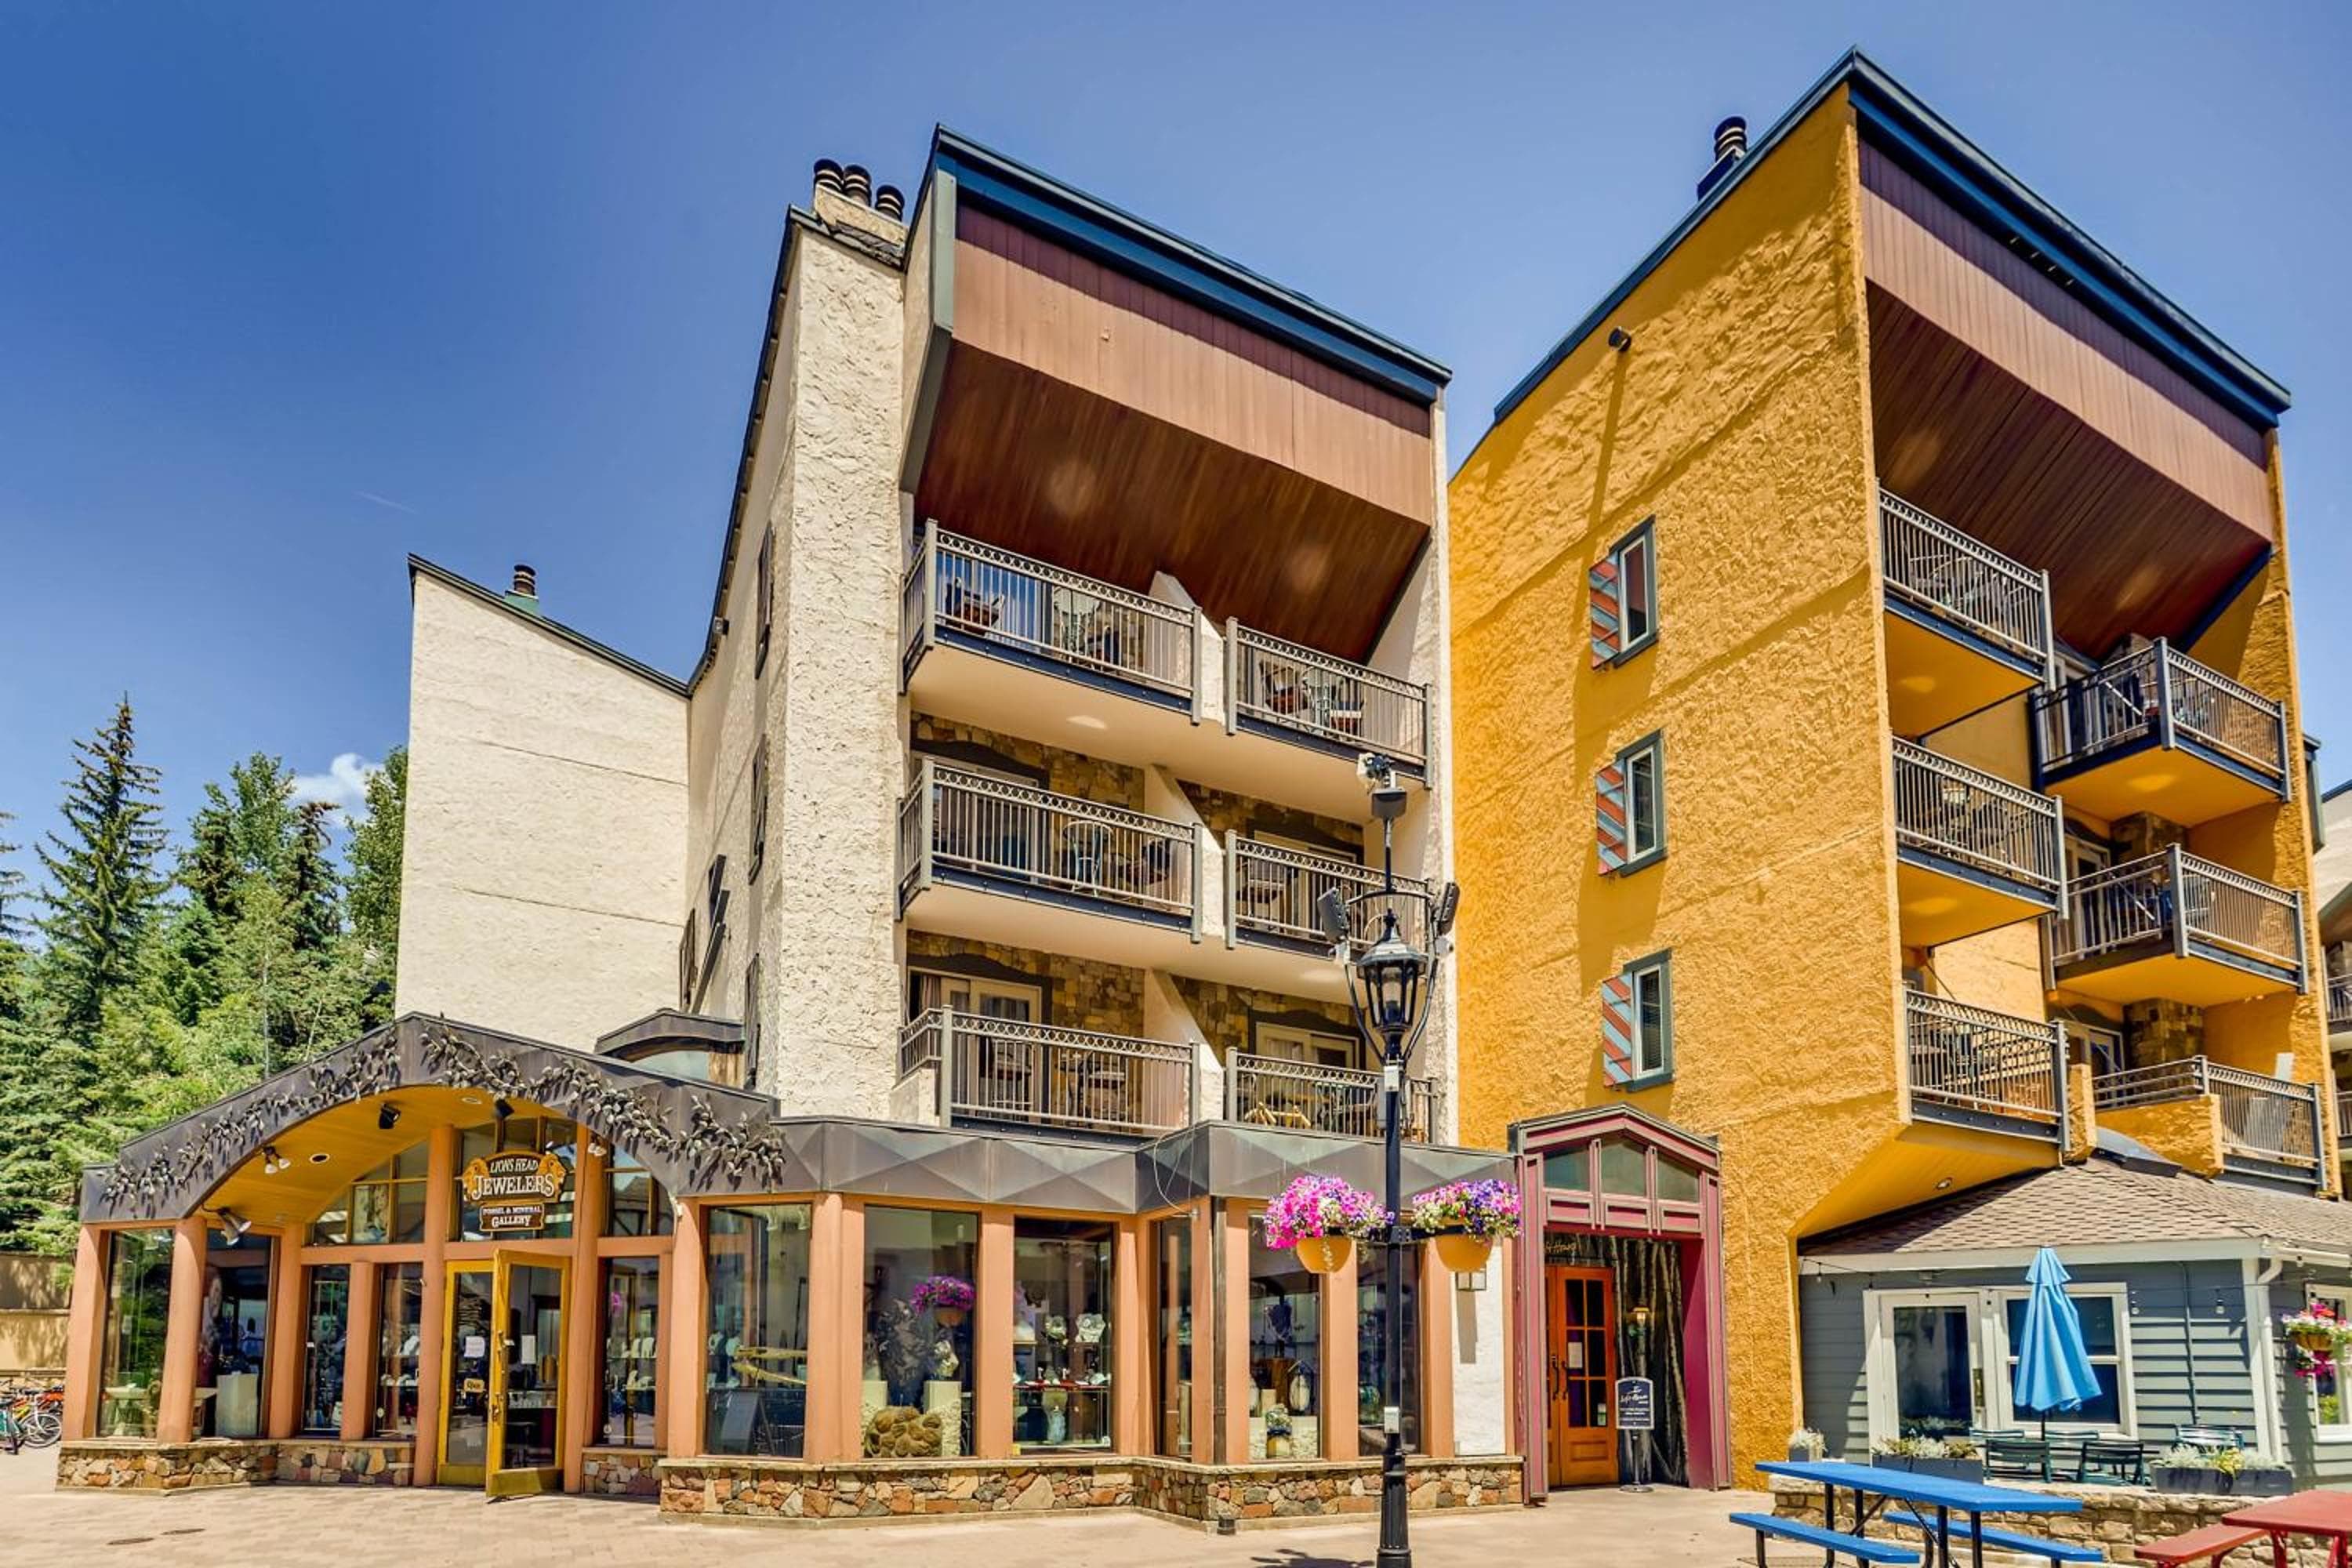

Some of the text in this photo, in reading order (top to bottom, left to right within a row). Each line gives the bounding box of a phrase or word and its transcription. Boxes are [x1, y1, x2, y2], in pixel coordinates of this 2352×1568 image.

[514, 1158, 539, 1171] HEAD
[471, 1174, 554, 1200] JEWELERS
[492, 1215, 532, 1228] GALLERY
